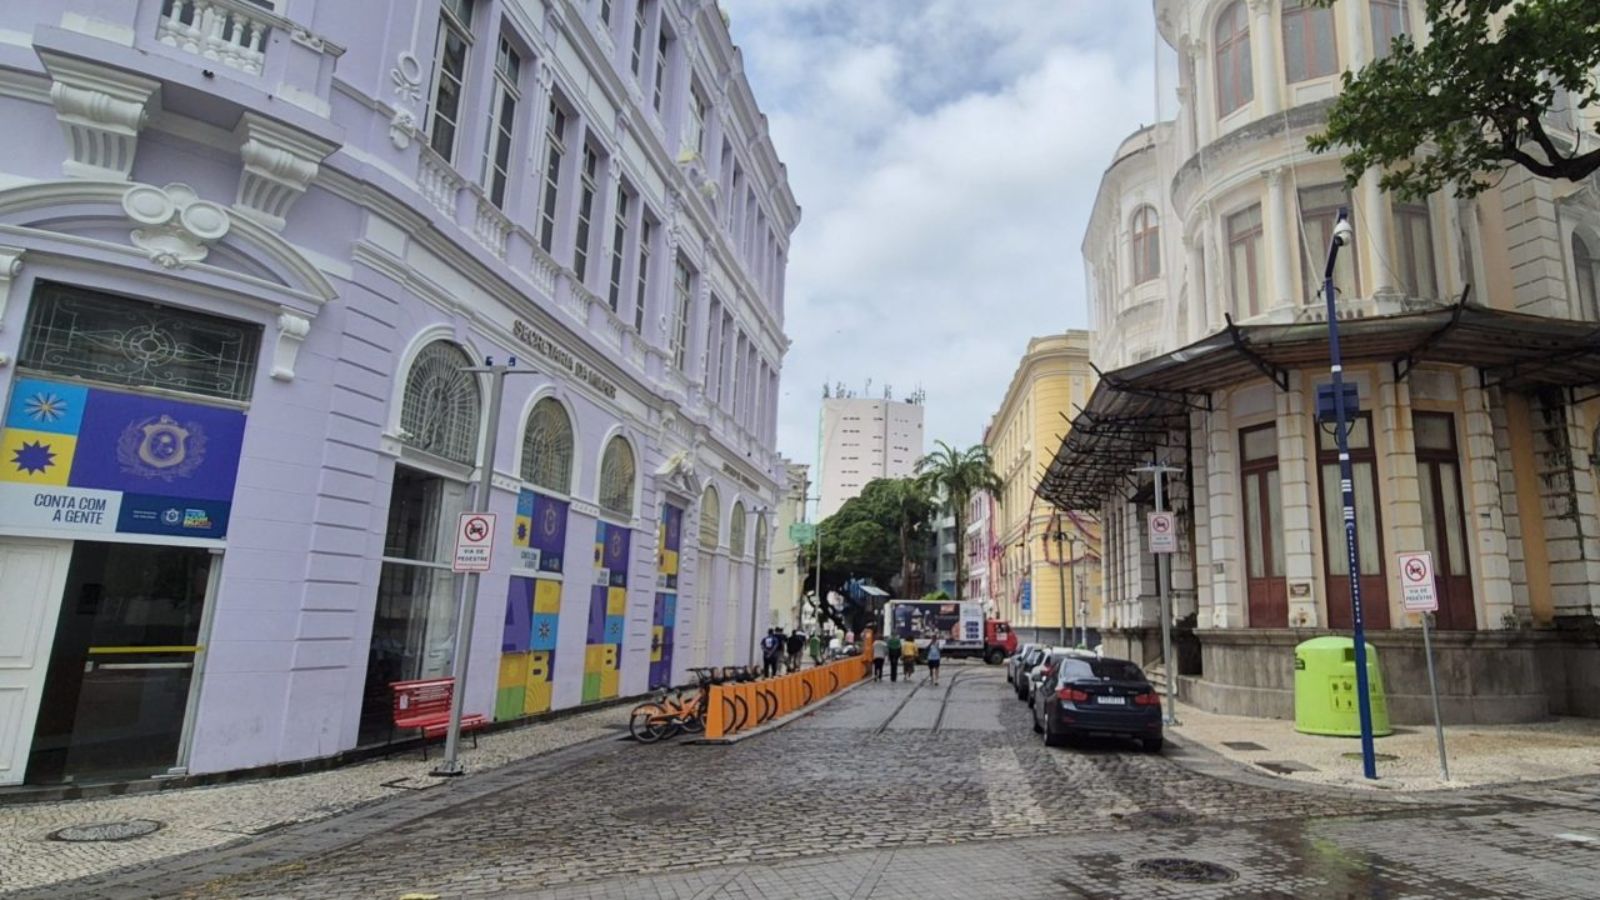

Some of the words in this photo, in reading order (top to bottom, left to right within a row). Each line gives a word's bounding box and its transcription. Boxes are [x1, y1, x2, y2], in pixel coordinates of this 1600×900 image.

[34, 493, 76, 509] CONTA
[79, 496, 107, 511] COM
[52, 509, 62, 522] A
[65, 509, 104, 525] GENTE
